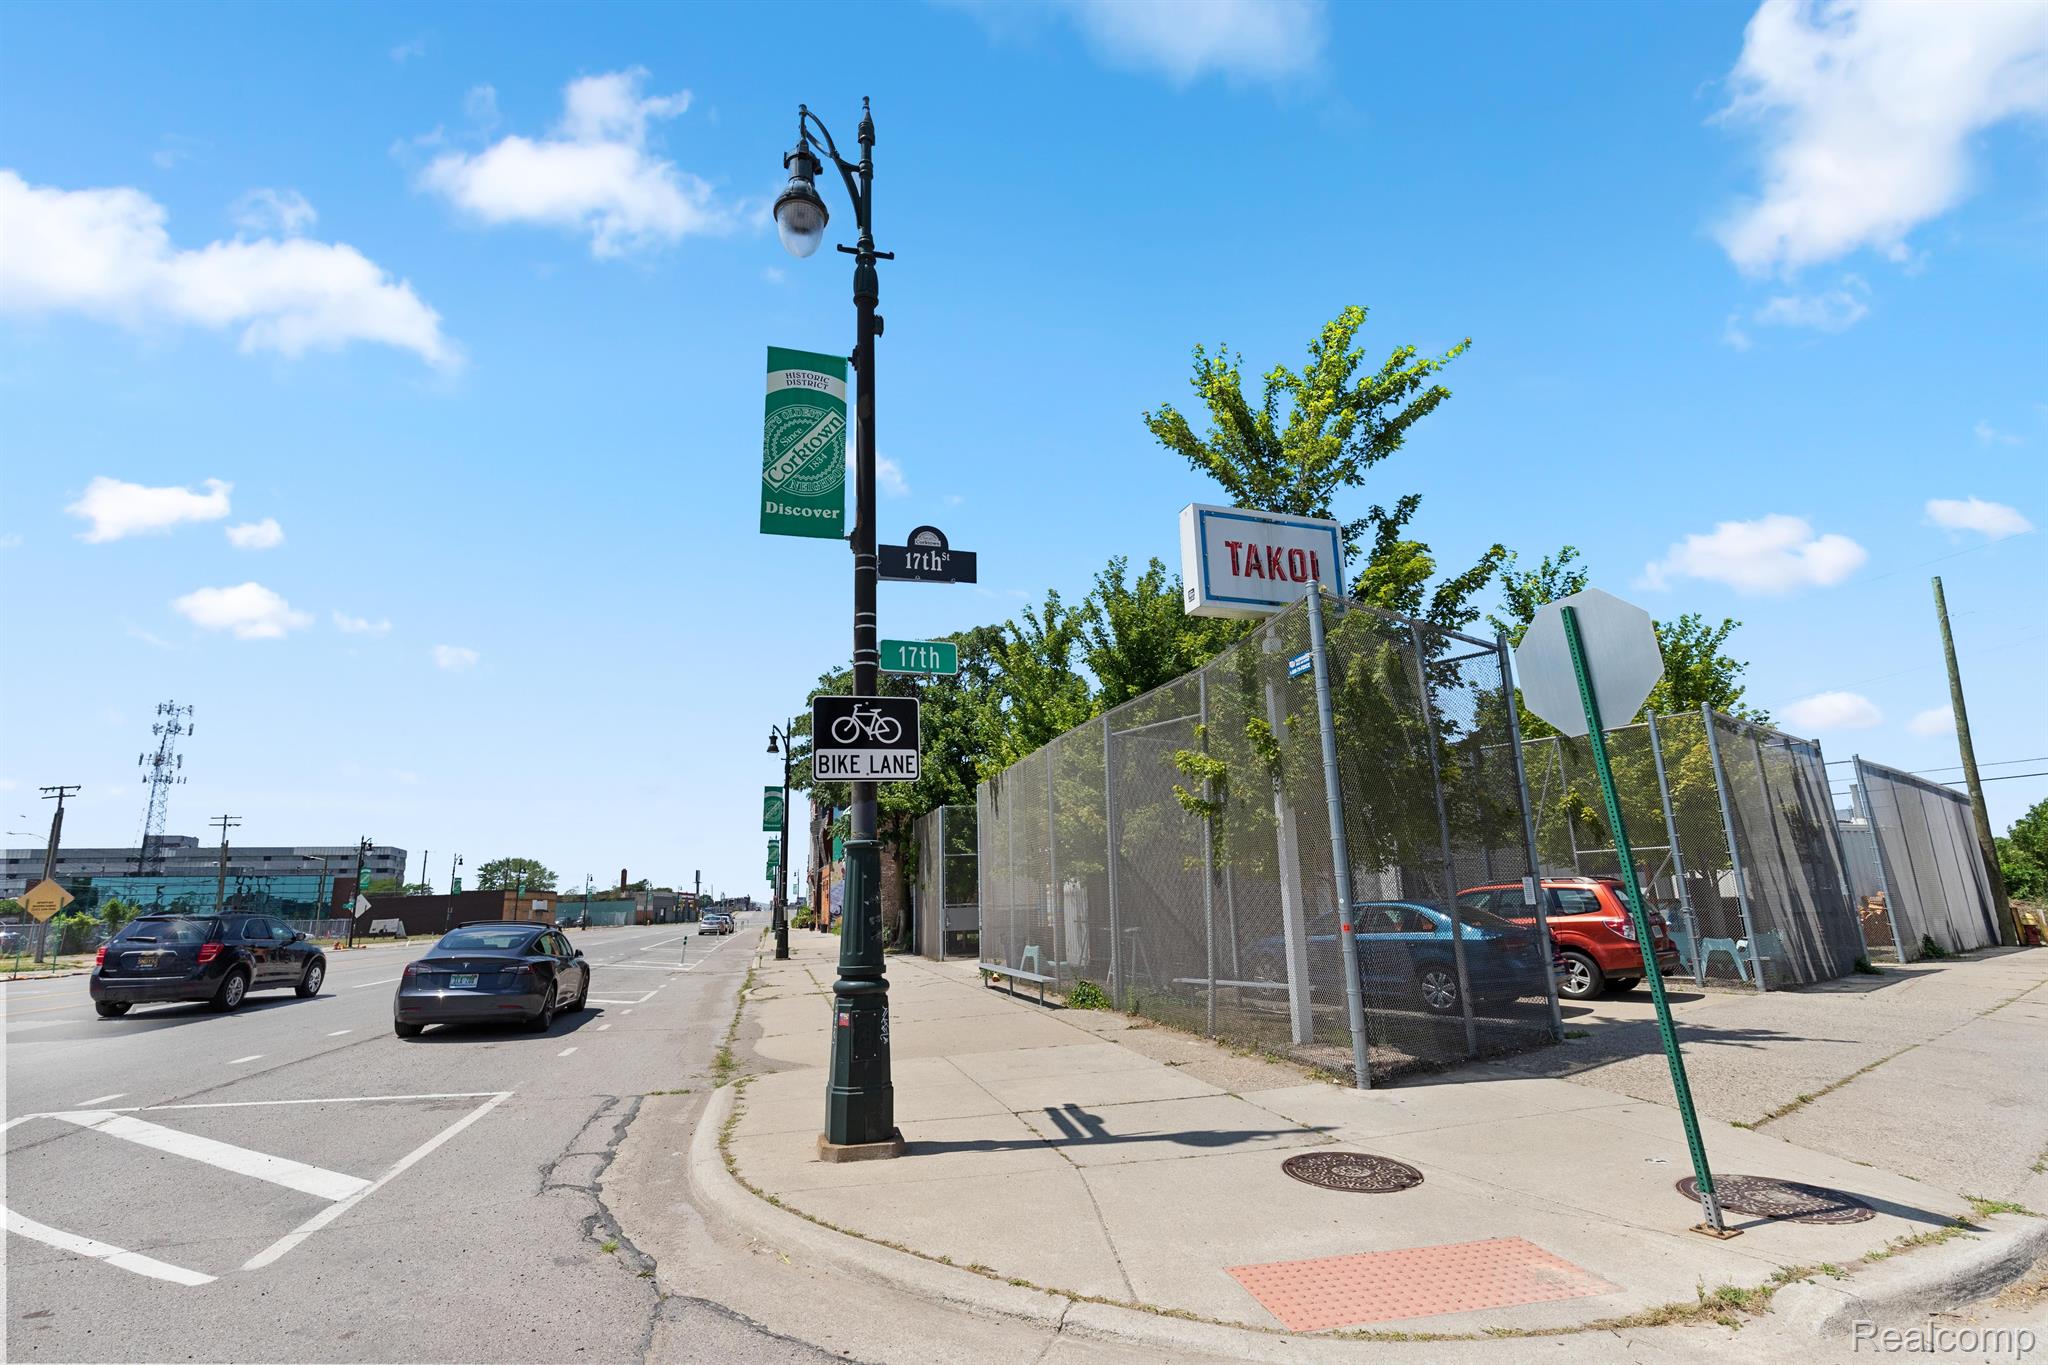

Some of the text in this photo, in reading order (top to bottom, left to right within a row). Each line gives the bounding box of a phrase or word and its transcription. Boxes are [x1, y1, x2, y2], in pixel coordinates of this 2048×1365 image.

[785, 372, 830, 384] HISTORIC
[786, 379, 829, 390] DISTRICT
[780, 428, 802, 447] Since
[767, 416, 844, 483] Corktown
[765, 501, 840, 519] Discover
[905, 550, 950, 571] 17th St
[1225, 540, 1320, 583] TAKOI
[899, 646, 940, 669] 17th
[818, 754, 915, 774] BIKE LANE
